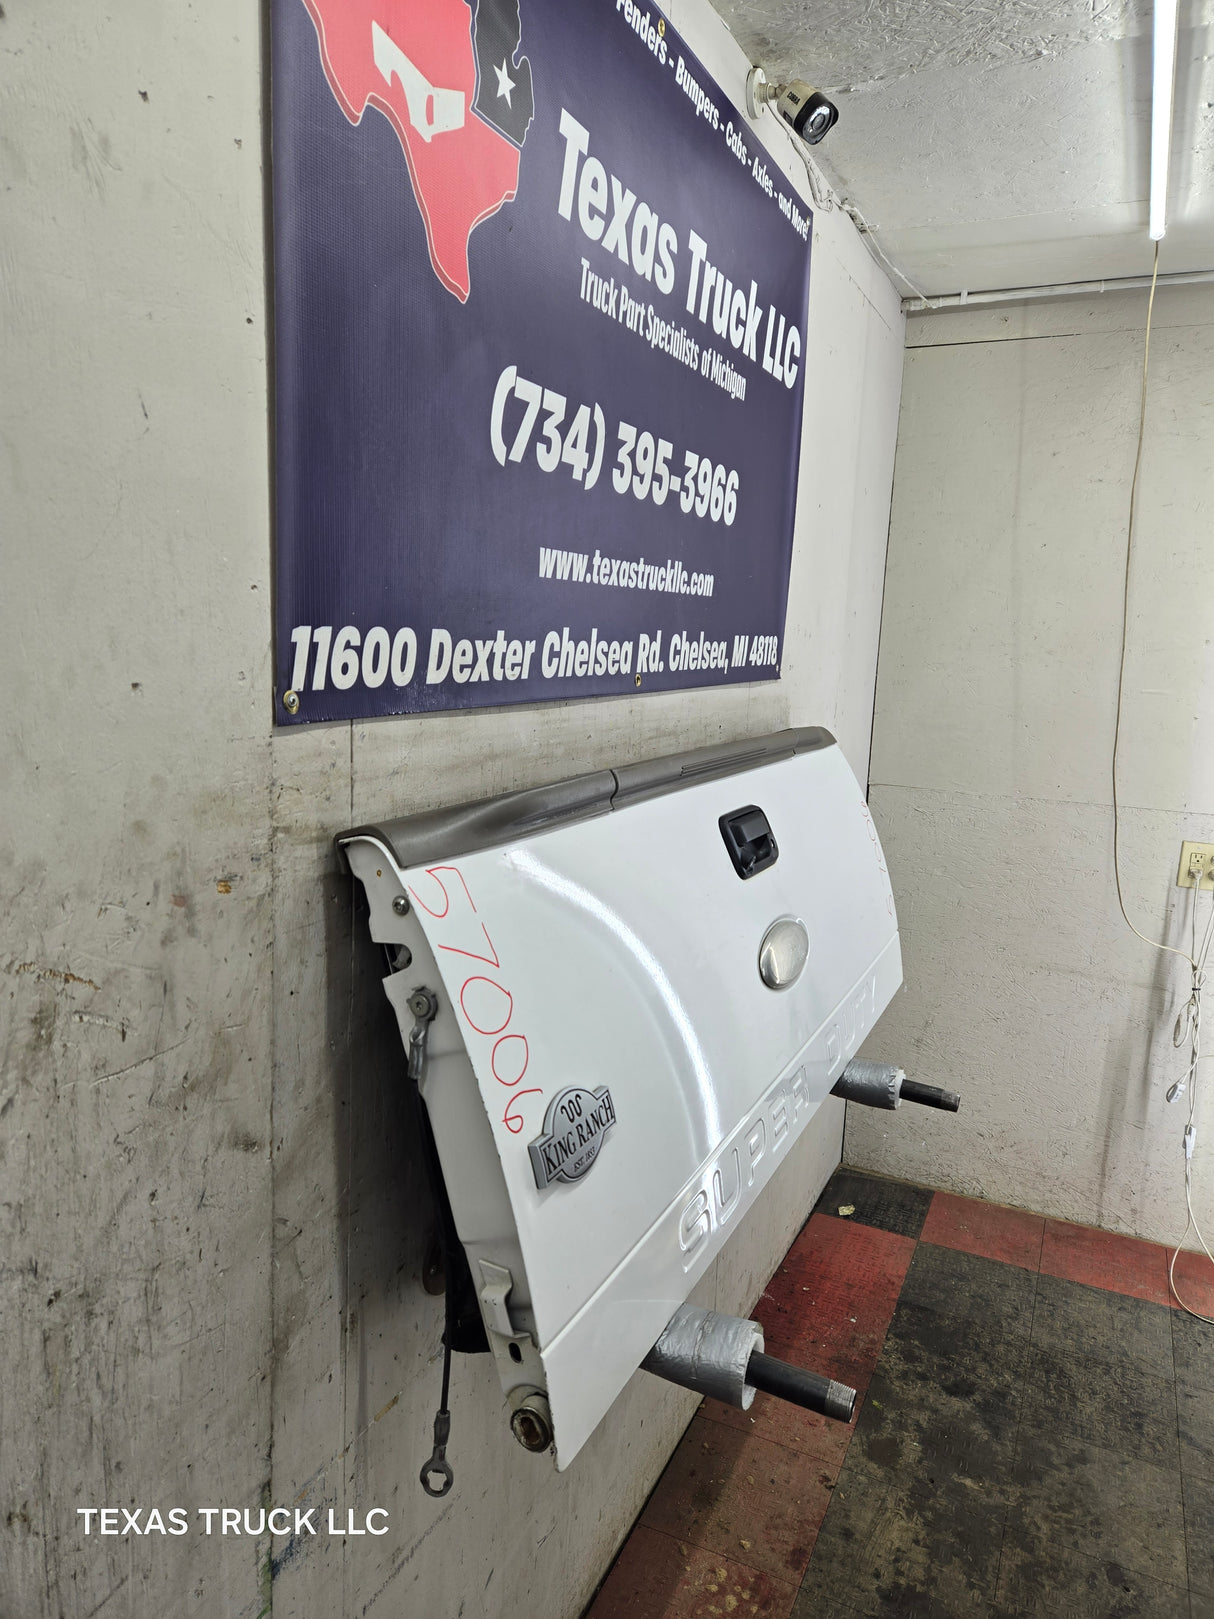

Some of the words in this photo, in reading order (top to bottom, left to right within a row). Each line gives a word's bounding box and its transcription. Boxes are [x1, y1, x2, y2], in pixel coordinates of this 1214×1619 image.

[675, 55, 720, 131] Bumpers
[725, 121, 748, 166] Cabs
[752, 156, 774, 198] Axles
[778, 191, 793, 220] and
[558, 108, 678, 295] Texas
[685, 229, 763, 362] Truck
[762, 304, 801, 389] LLC
[580, 256, 619, 320] Truck
[618, 284, 647, 337] Part
[645, 304, 700, 371] Specialists
[700, 347, 712, 379] of
[711, 350, 747, 402] Michigan
[490, 365, 606, 491] (734)
[612, 421, 740, 526] 395-3966
[539, 546, 715, 597] www.texastruckllc.com
[290, 625, 417, 695] 11600
[425, 629, 537, 685] Dexter
[542, 627, 634, 679] Chelsea
[636, 630, 664, 674] Rd.
[669, 631, 729, 675] Chelsea,
[730, 635, 749, 668] MI
[748, 635, 778, 666] 48118
[407, 865, 544, 1135] 57006
[542, 1131, 577, 1176] KING
[575, 1094, 615, 1148] RANCH
[678, 1064, 811, 1274] SUPER
